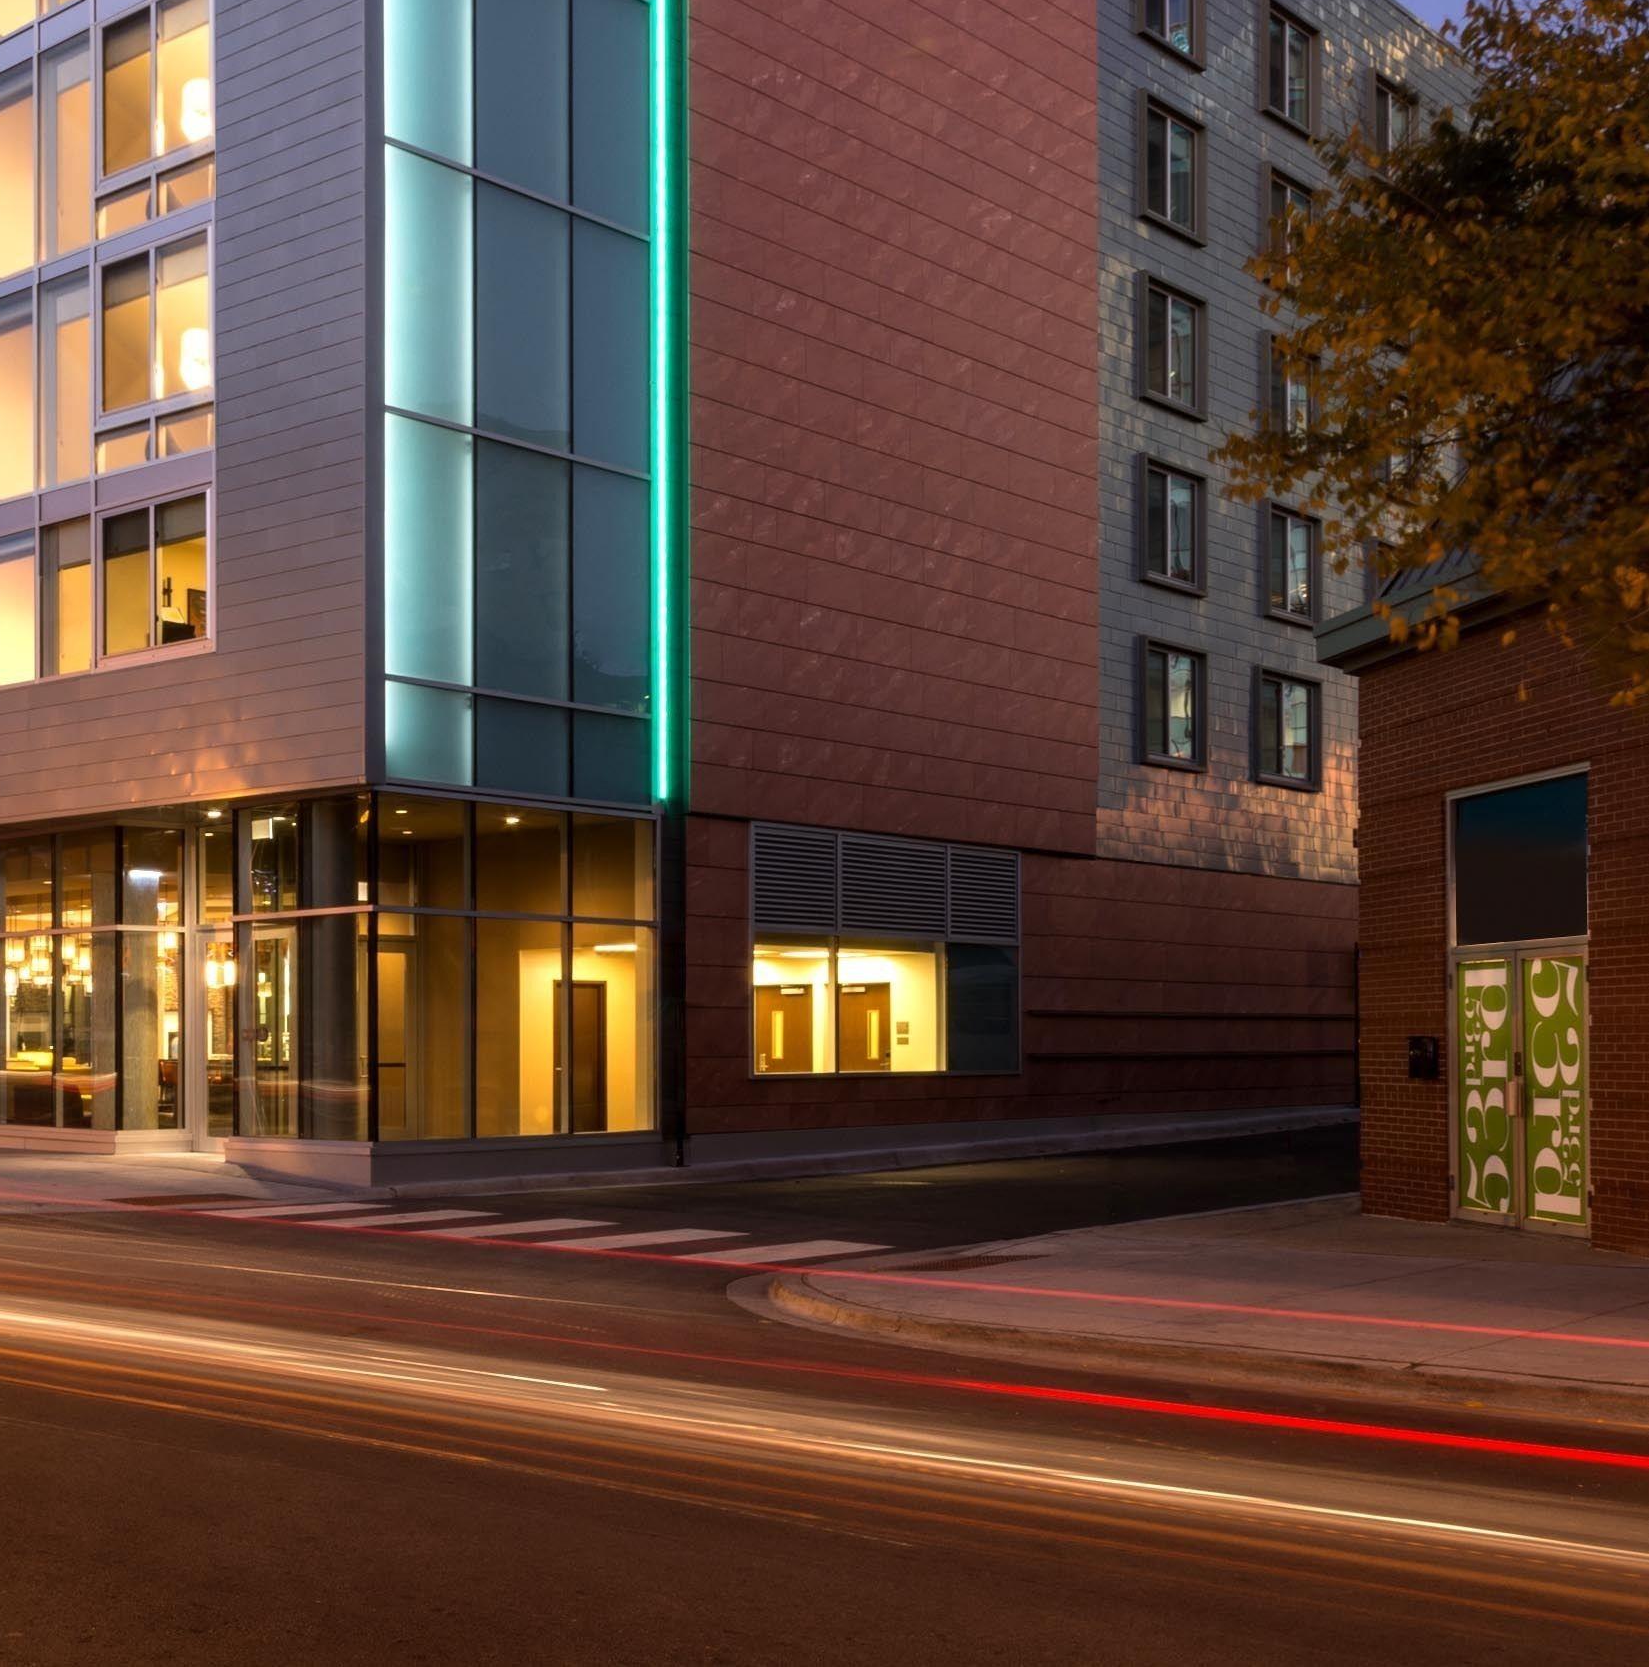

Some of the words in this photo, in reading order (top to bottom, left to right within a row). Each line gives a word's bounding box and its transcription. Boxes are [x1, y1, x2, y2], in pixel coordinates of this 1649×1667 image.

[1463, 997, 1483, 1086] 53rd
[1463, 958, 1511, 1214] 53rd
[1530, 957, 1581, 1216] 53rd
[1561, 1089, 1581, 1187] 53rd
